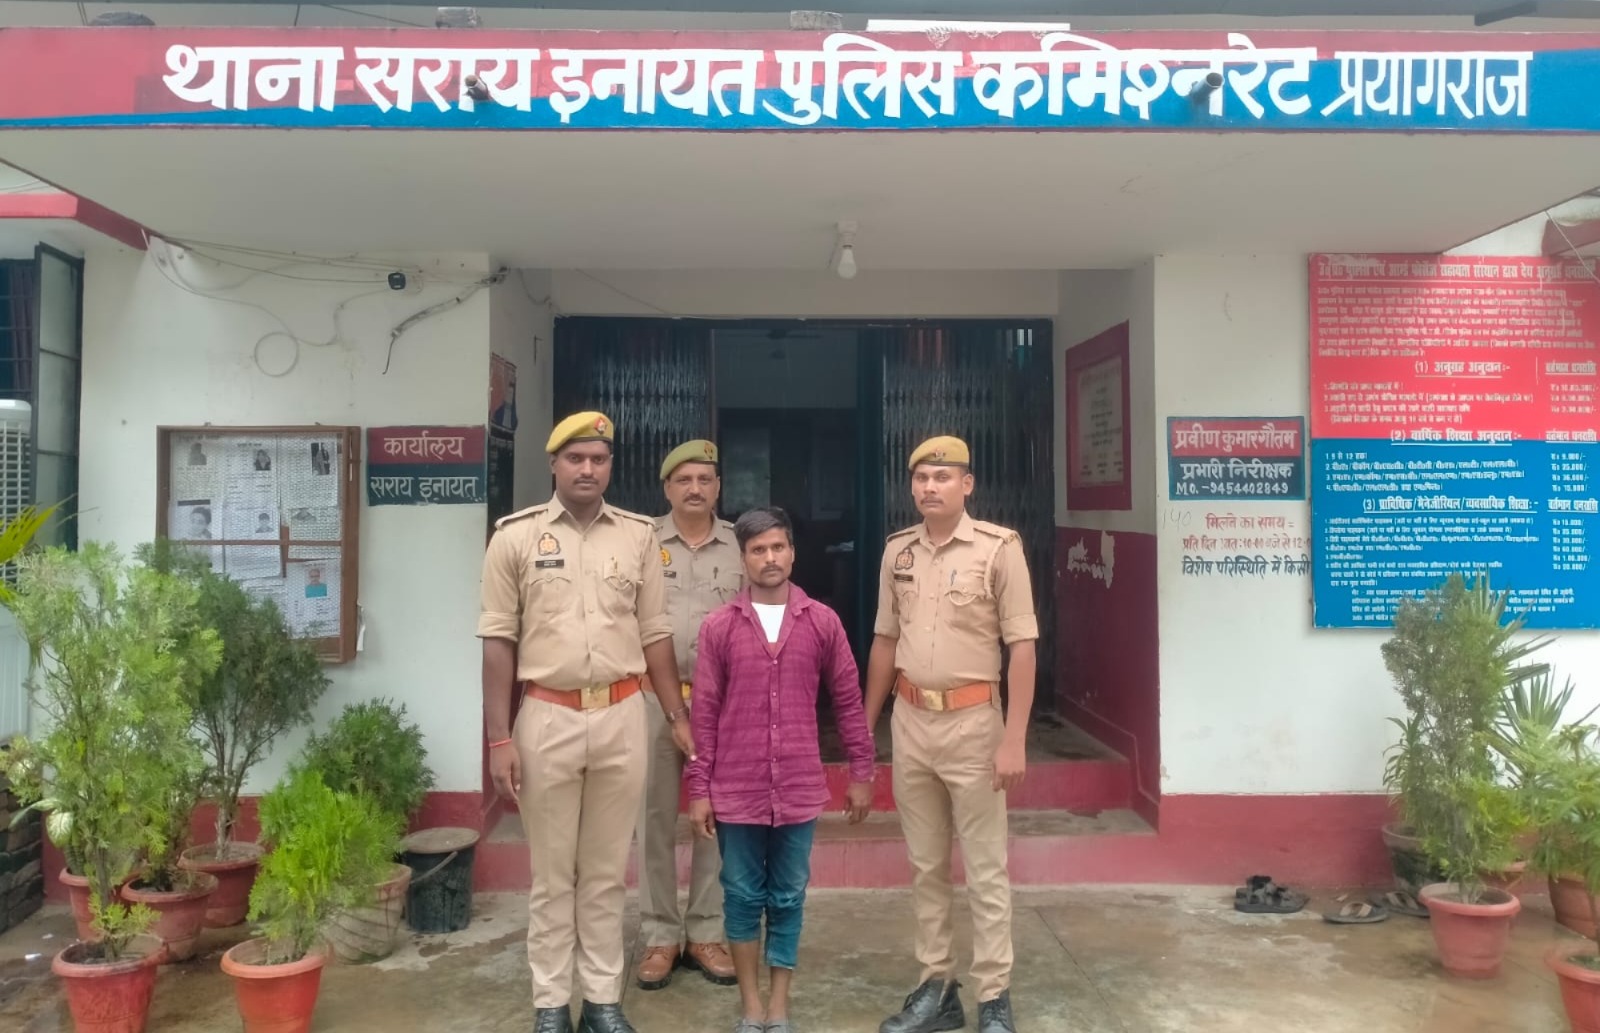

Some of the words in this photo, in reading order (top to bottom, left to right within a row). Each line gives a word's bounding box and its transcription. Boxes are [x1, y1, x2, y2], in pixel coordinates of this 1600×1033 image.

[162, 44, 344, 112] थाना
[355, 47, 540, 113] सराय
[549, 48, 764, 123] इनायत
[763, 33, 964, 126] पुलिस
[970, 33, 1317, 120] कमिश्नरेट
[1320, 51, 1534, 119] प्रयागराज
[384, 430, 465, 461] कार्यालय
[1174, 423, 1220, 449] प्रवीण
[1180, 458, 1225, 480] प्रभारी
[1228, 458, 1294, 481] निरीक्षक
[370, 476, 414, 498] सराय
[418, 476, 478, 505] इनायत
[1363, 497, 1376, 511] (3)
[1240, 516, 1254, 529] का
[1257, 516, 1286, 530] समय
[1182, 555, 1215, 576] विशेष
[1215, 555, 1269, 578] परिस्थिति
[1270, 554, 1282, 575] में
